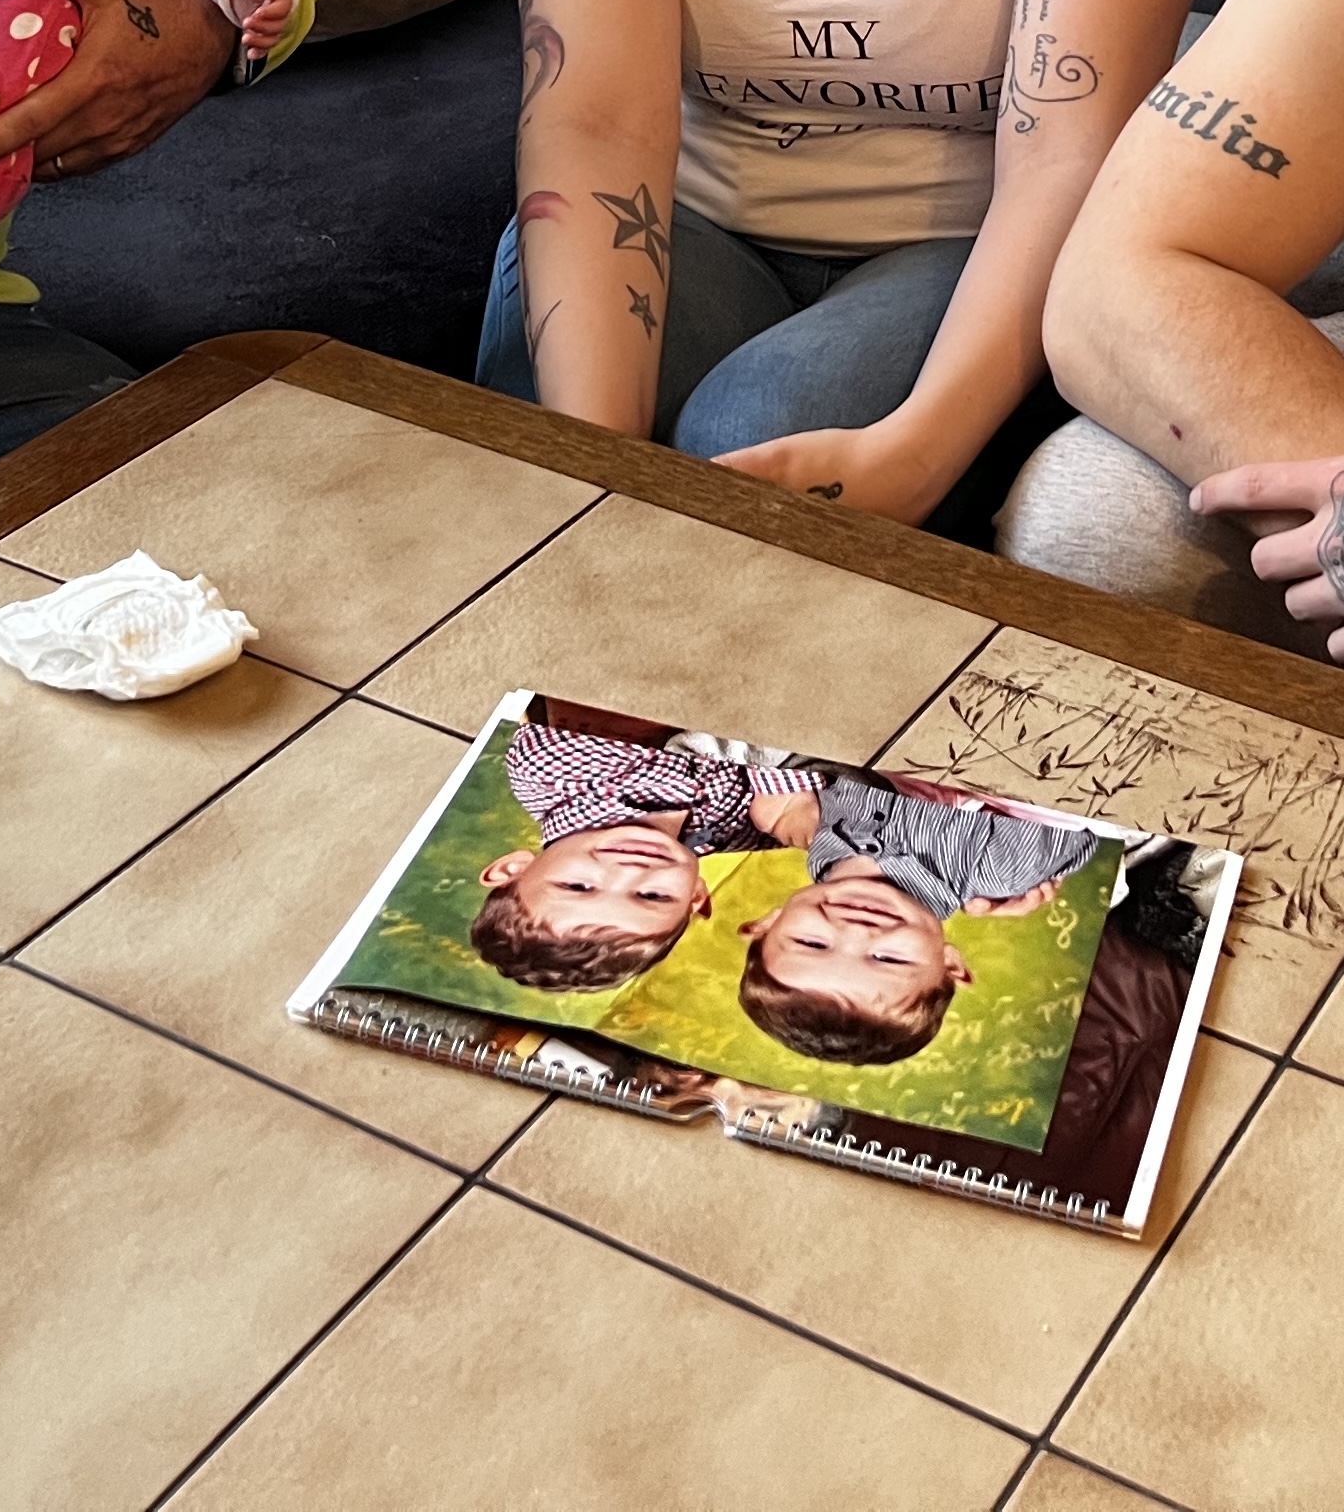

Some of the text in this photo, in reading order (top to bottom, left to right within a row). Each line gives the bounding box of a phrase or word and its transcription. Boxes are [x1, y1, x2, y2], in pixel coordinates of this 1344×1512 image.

[786, 19, 881, 60] MY
[695, 69, 1005, 115] FAVORITE
[1147, 78, 1292, 180] milio
